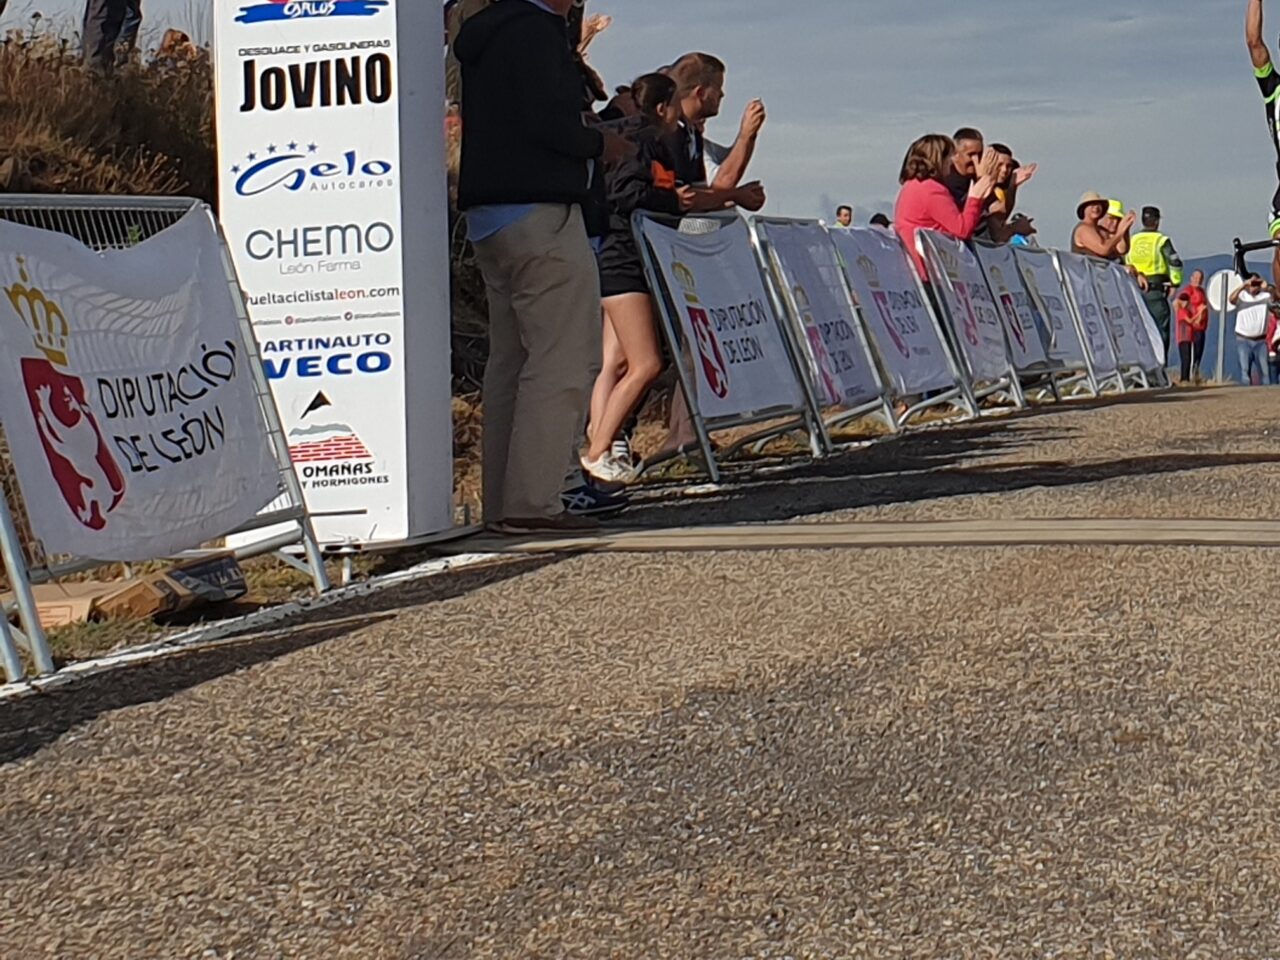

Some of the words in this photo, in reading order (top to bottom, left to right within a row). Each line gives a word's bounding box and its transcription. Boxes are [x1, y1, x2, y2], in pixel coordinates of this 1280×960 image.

[283, 0, 337, 18] CARLOS
[238, 45, 301, 57] DESGUACE
[305, 44, 311, 53] Y
[313, 39, 391, 52] GASOLINERAS
[310, 178, 393, 191] Autocares
[245, 221, 394, 261] CHEMO
[280, 261, 314, 275] León
[318, 259, 361, 273] Farma
[256, 332, 392, 353] ARTINAUTO
[263, 351, 392, 379] VECO
[115, 435, 159, 473] DE
[150, 405, 226, 463] LEÓN
[303, 461, 374, 478] OMAÑAS
[312, 475, 390, 489] HORMIGONES
